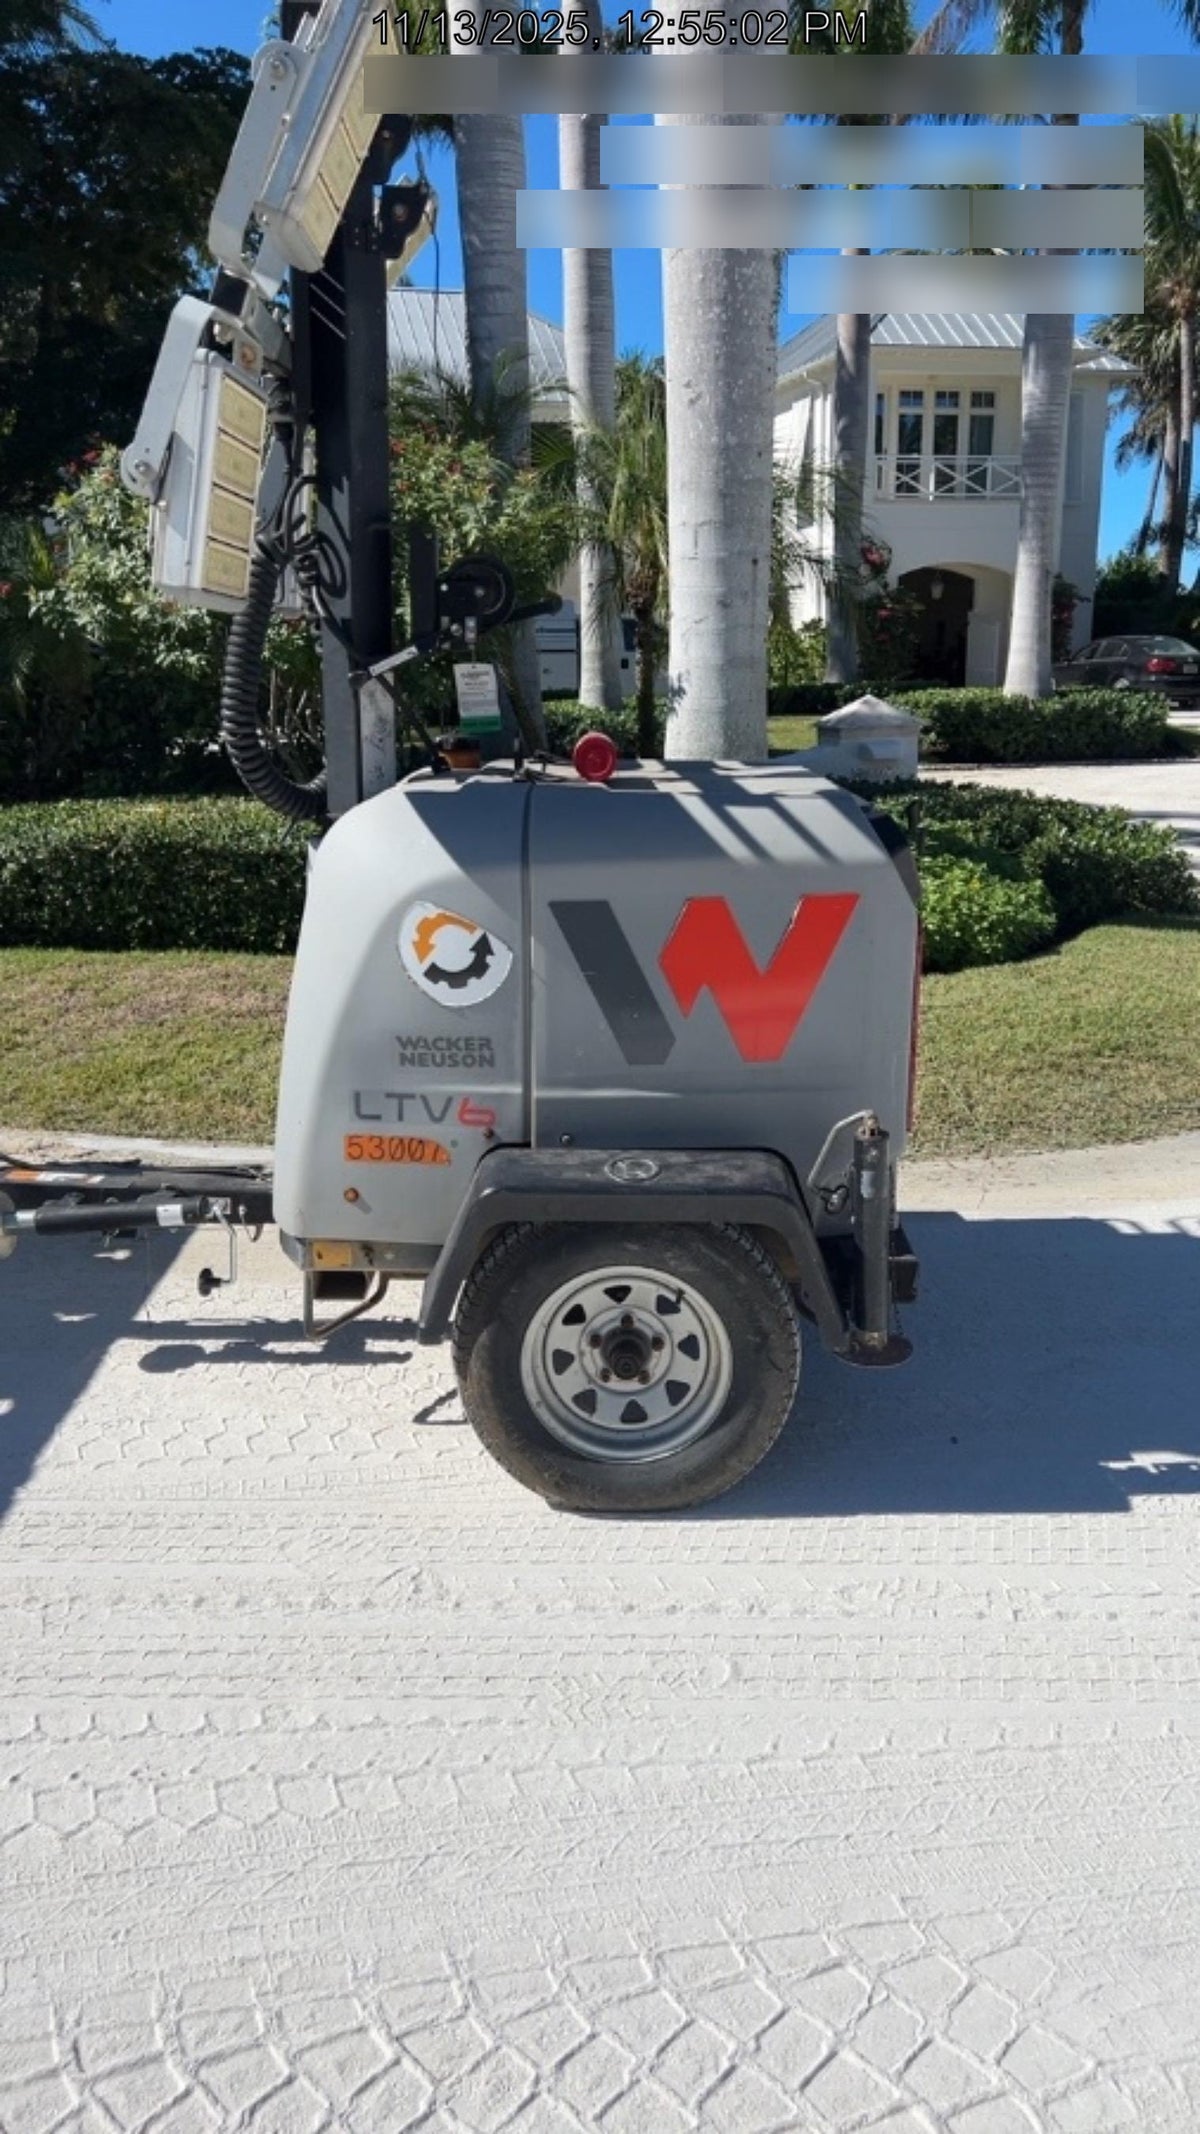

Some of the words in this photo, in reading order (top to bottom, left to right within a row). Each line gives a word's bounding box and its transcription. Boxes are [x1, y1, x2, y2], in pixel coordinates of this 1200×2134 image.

[396, 1035, 494, 1051] WACKER
[400, 1052, 495, 1068] NEUSON
[354, 1091, 496, 1127] LTV6
